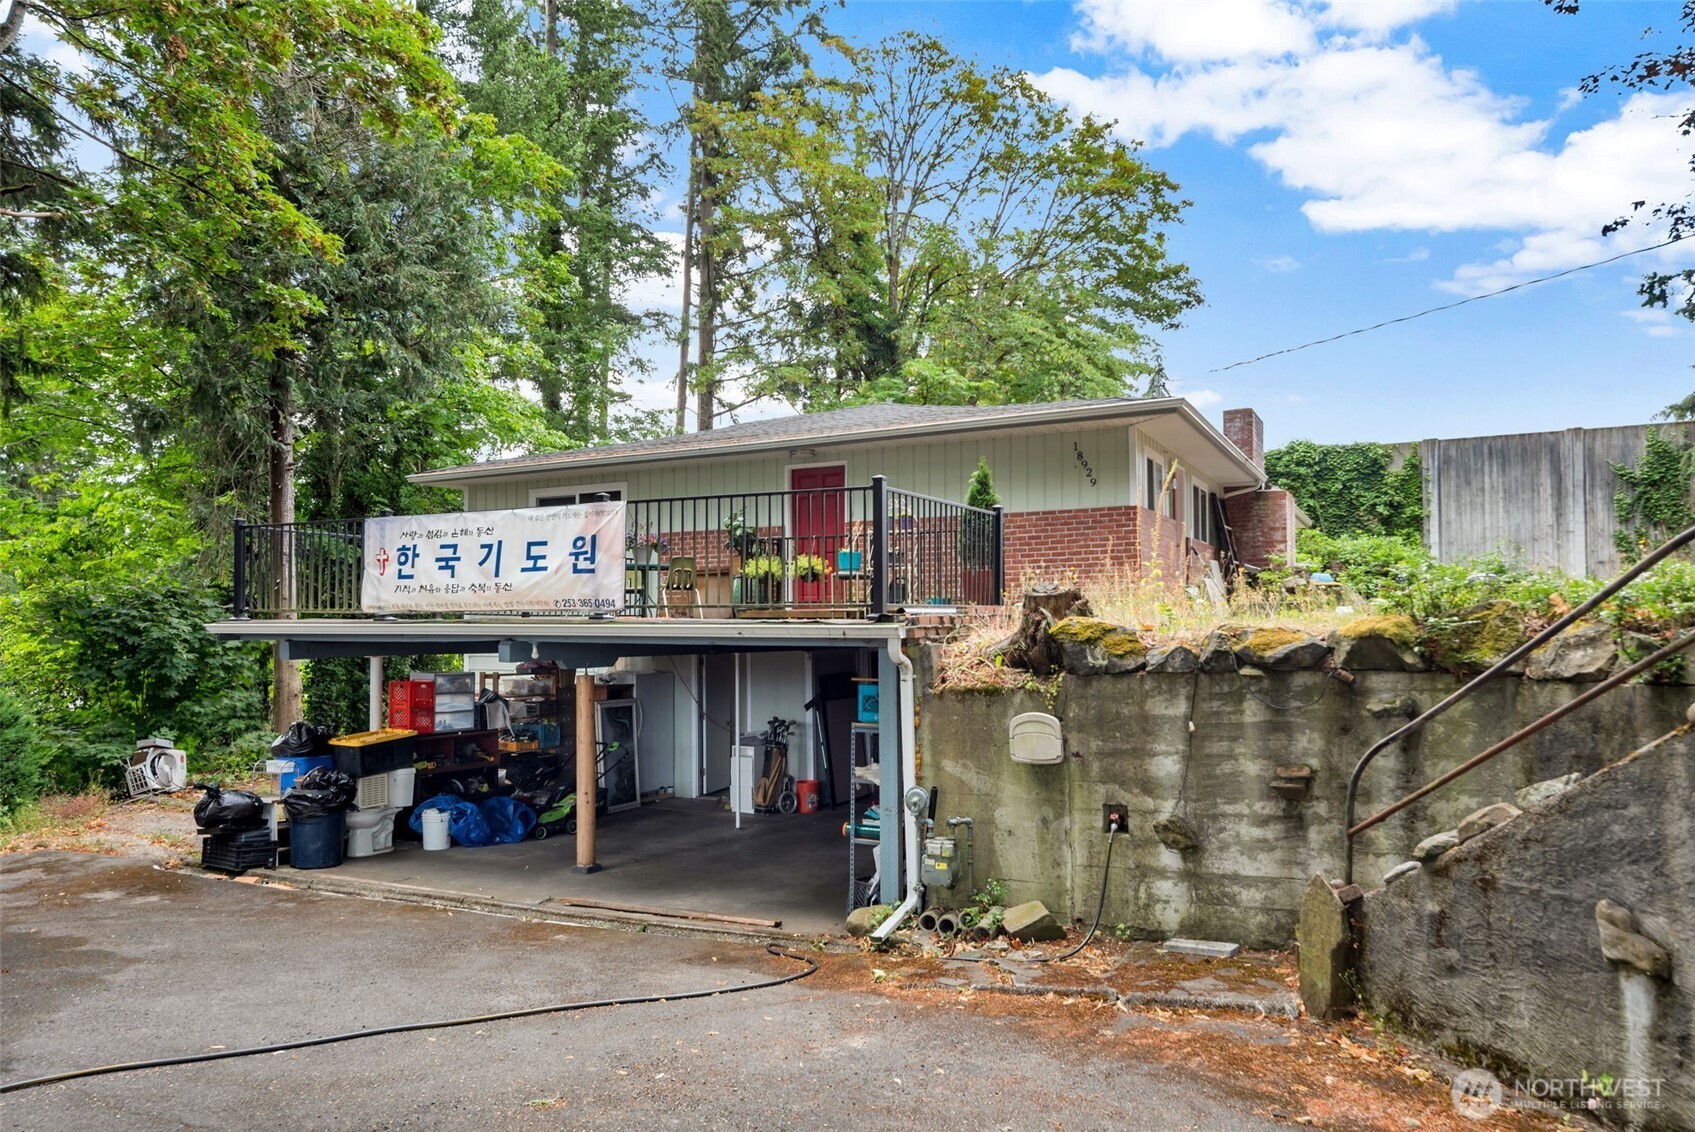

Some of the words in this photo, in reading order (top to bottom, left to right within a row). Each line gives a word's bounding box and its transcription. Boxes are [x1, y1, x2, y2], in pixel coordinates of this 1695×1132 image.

[1073, 442, 1097, 488] 18929
[476, 526, 496, 538] 동산
[396, 534, 597, 580] 한국기도원
[494, 582, 513, 594] 동산
